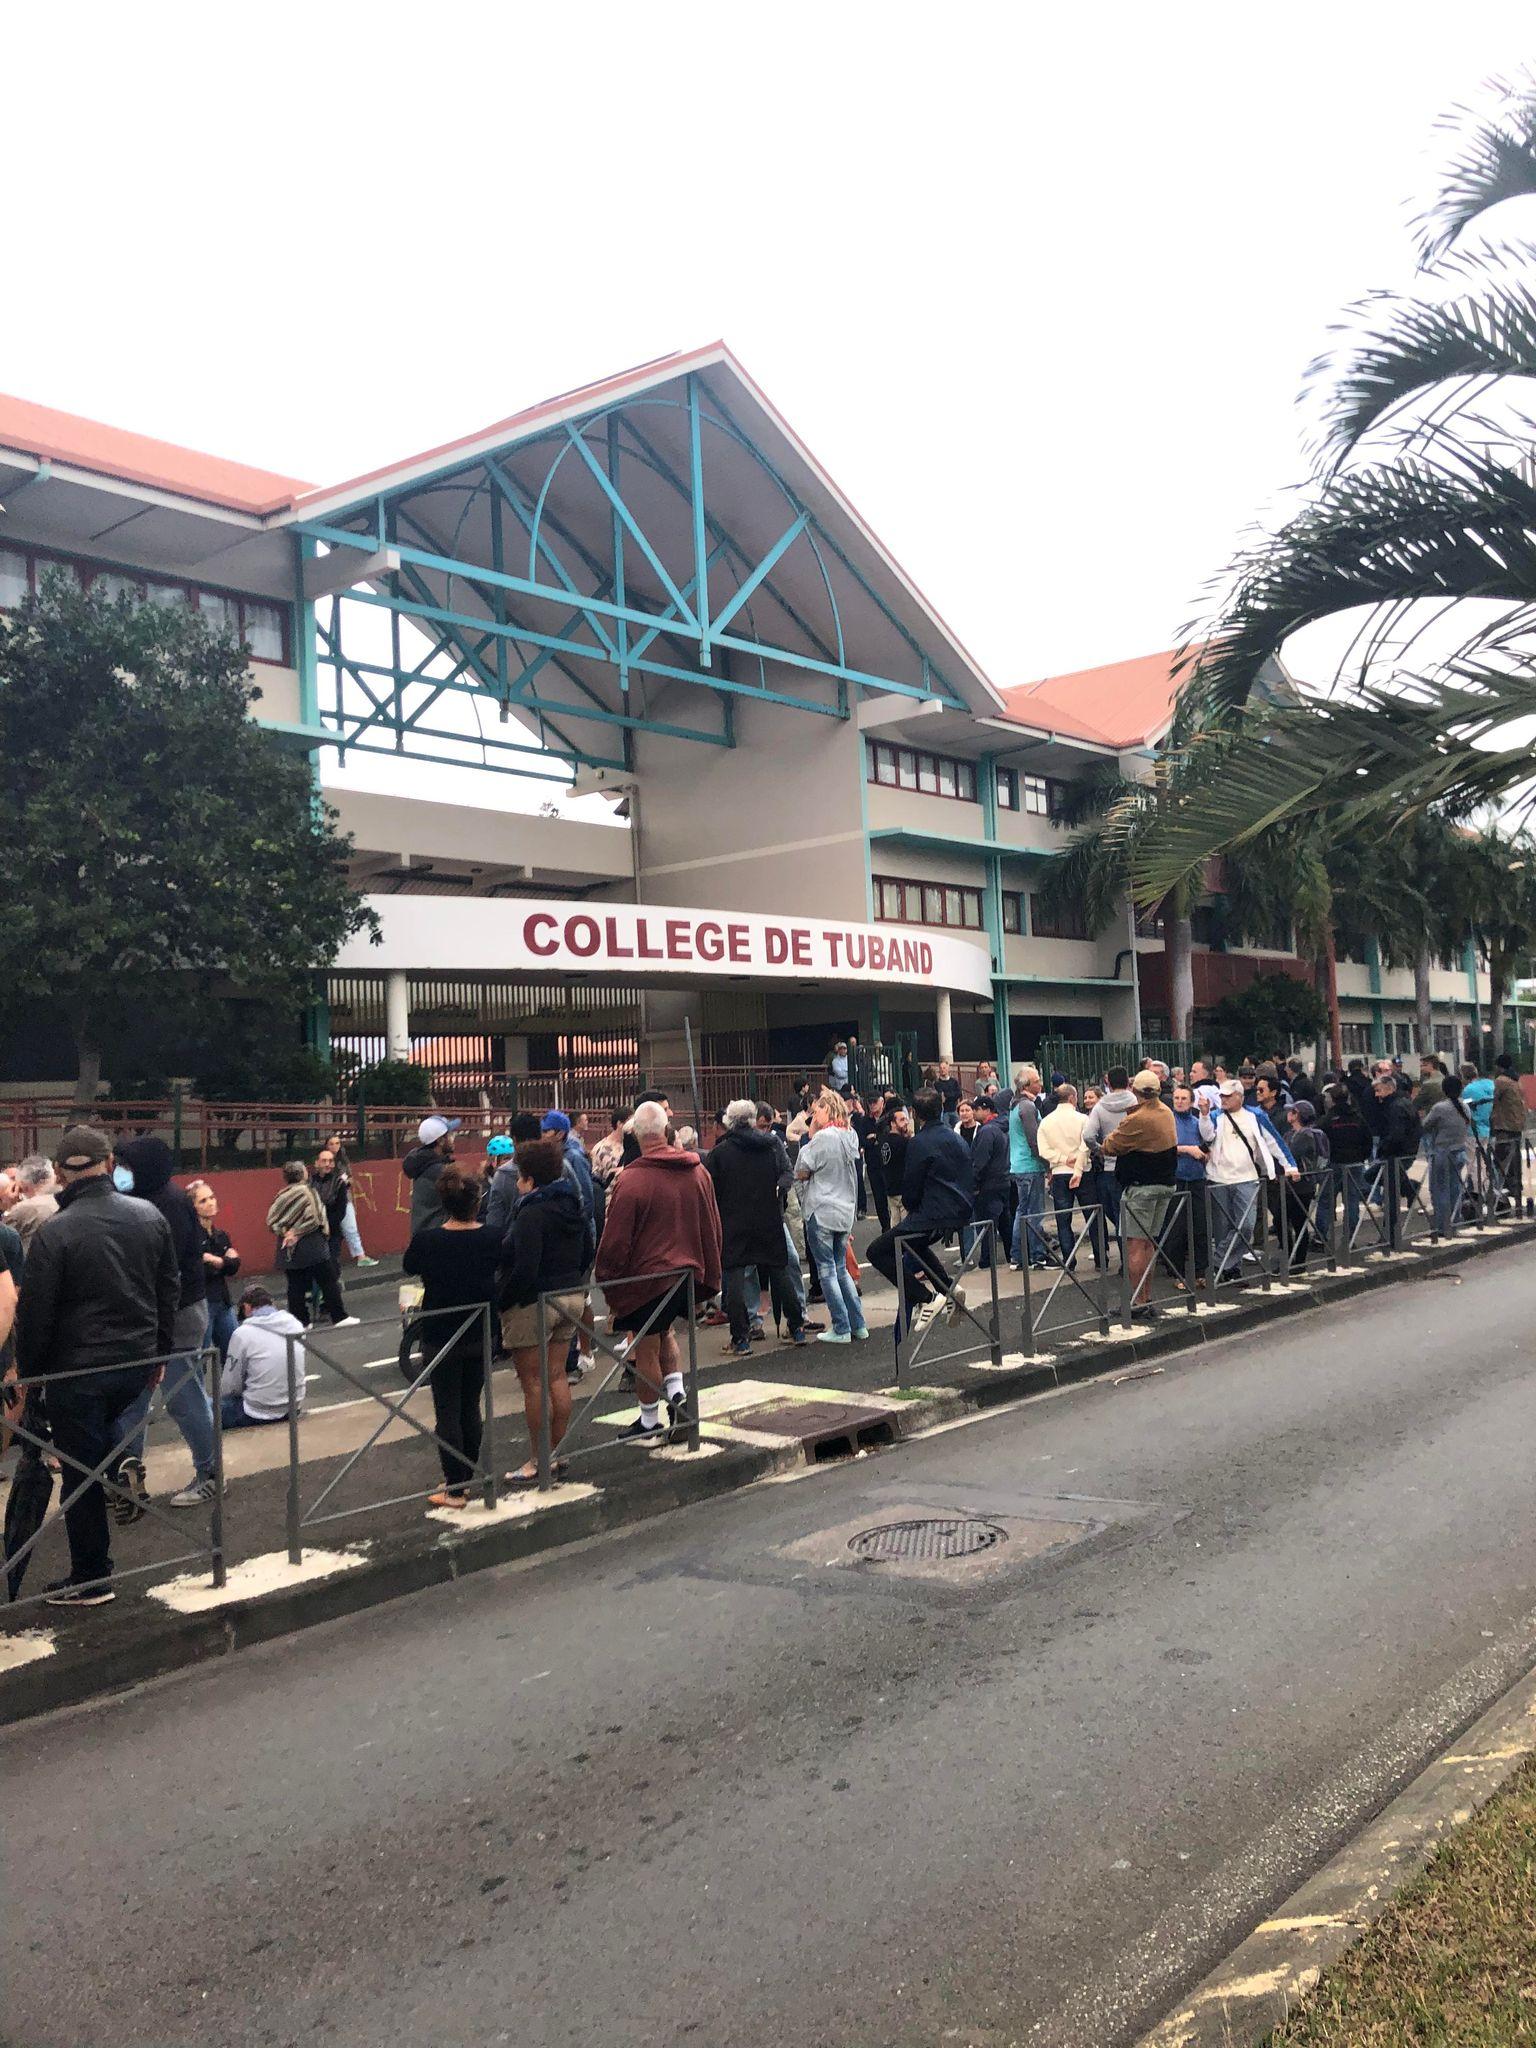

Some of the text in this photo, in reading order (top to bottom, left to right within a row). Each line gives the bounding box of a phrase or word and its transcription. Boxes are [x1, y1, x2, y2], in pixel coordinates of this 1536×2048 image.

[523, 913, 933, 975] COLLEGE DE TUBAND
